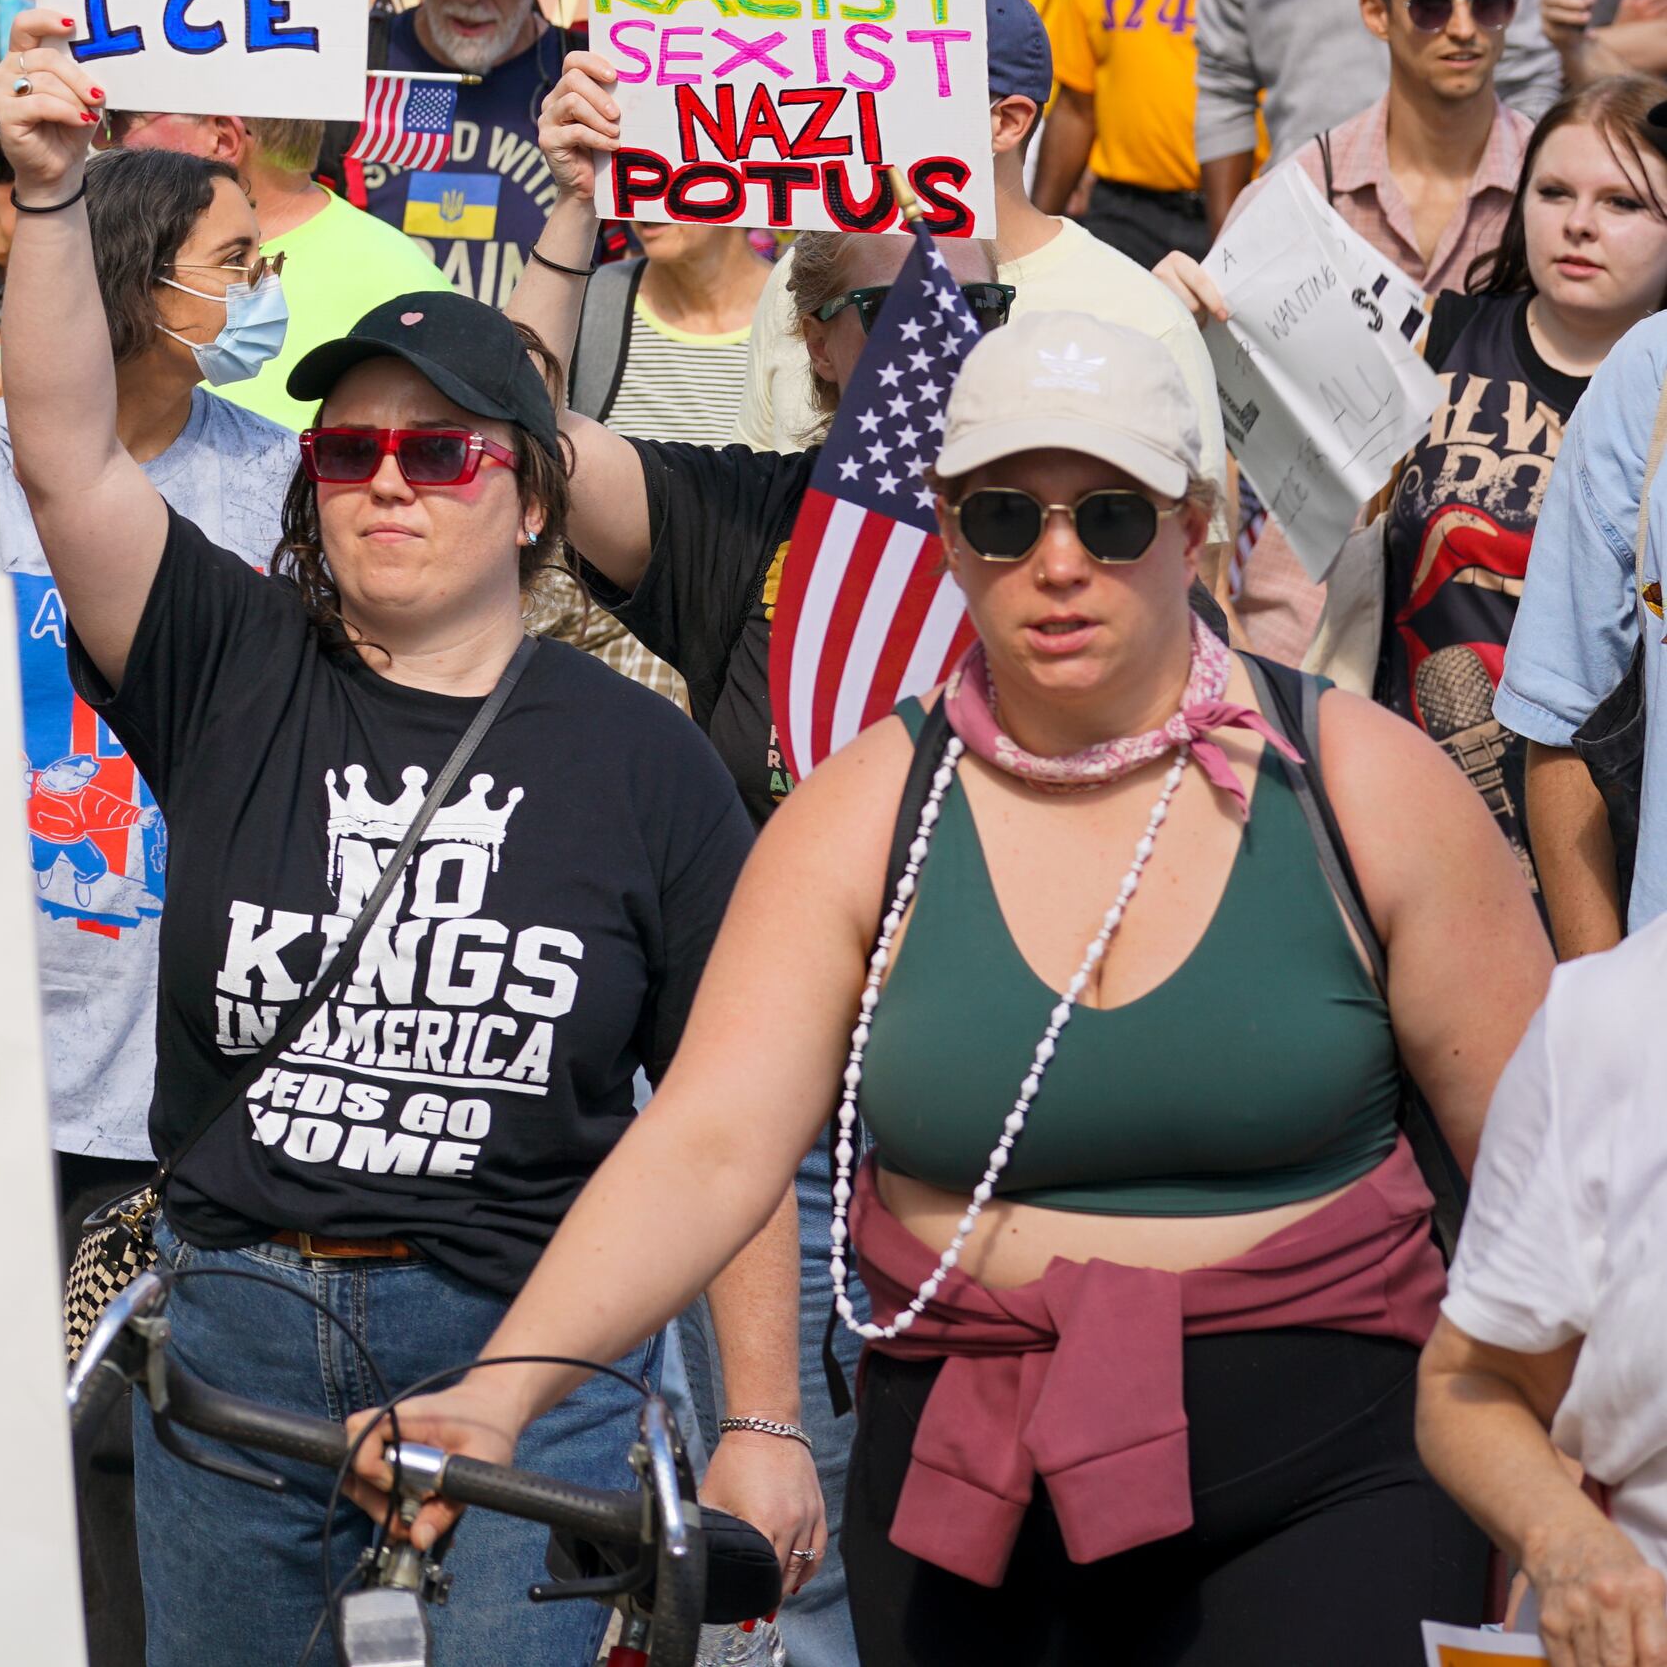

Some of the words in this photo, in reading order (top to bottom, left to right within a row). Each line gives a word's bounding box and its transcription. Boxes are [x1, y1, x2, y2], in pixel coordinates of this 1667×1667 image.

[608, 18, 972, 99] SEXIST
[674, 81, 884, 165] NAZI
[609, 146, 977, 239] POTUS
[1264, 264, 1338, 341] WANTING
[332, 837, 491, 930] NO
[214, 996, 281, 1048] IN
[290, 1000, 555, 1082] AMERICA
[247, 1067, 390, 1122] FEDS
[399, 1092, 492, 1139] GO
